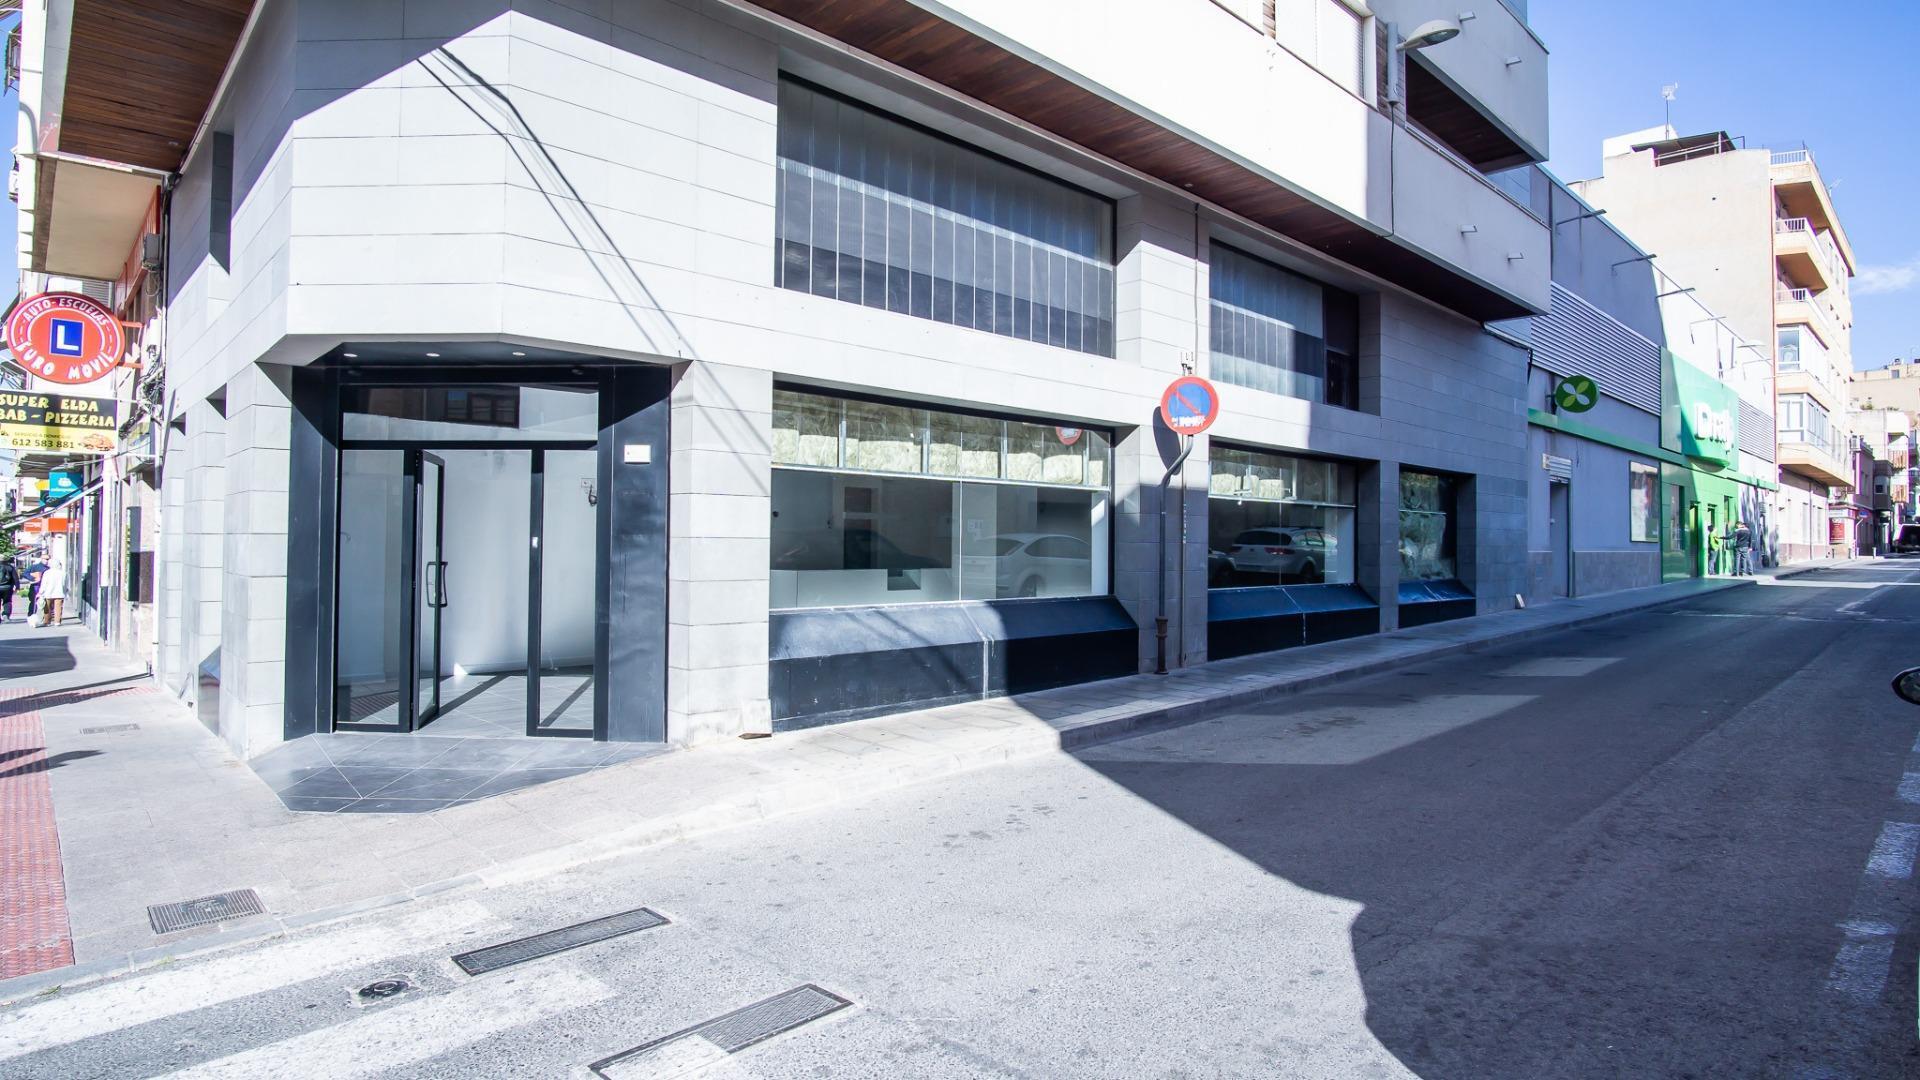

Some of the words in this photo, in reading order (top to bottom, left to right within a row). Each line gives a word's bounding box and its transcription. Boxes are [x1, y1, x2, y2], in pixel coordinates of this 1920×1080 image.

[56, 324, 79, 351] L
[68, 351, 114, 380] MOVIL
[61, 398, 99, 412] ELDA
[45, 411, 115, 427] PIZZERIA
[12, 438, 31, 446] 612
[35, 439, 54, 448] 583
[56, 440, 75, 449] 881
